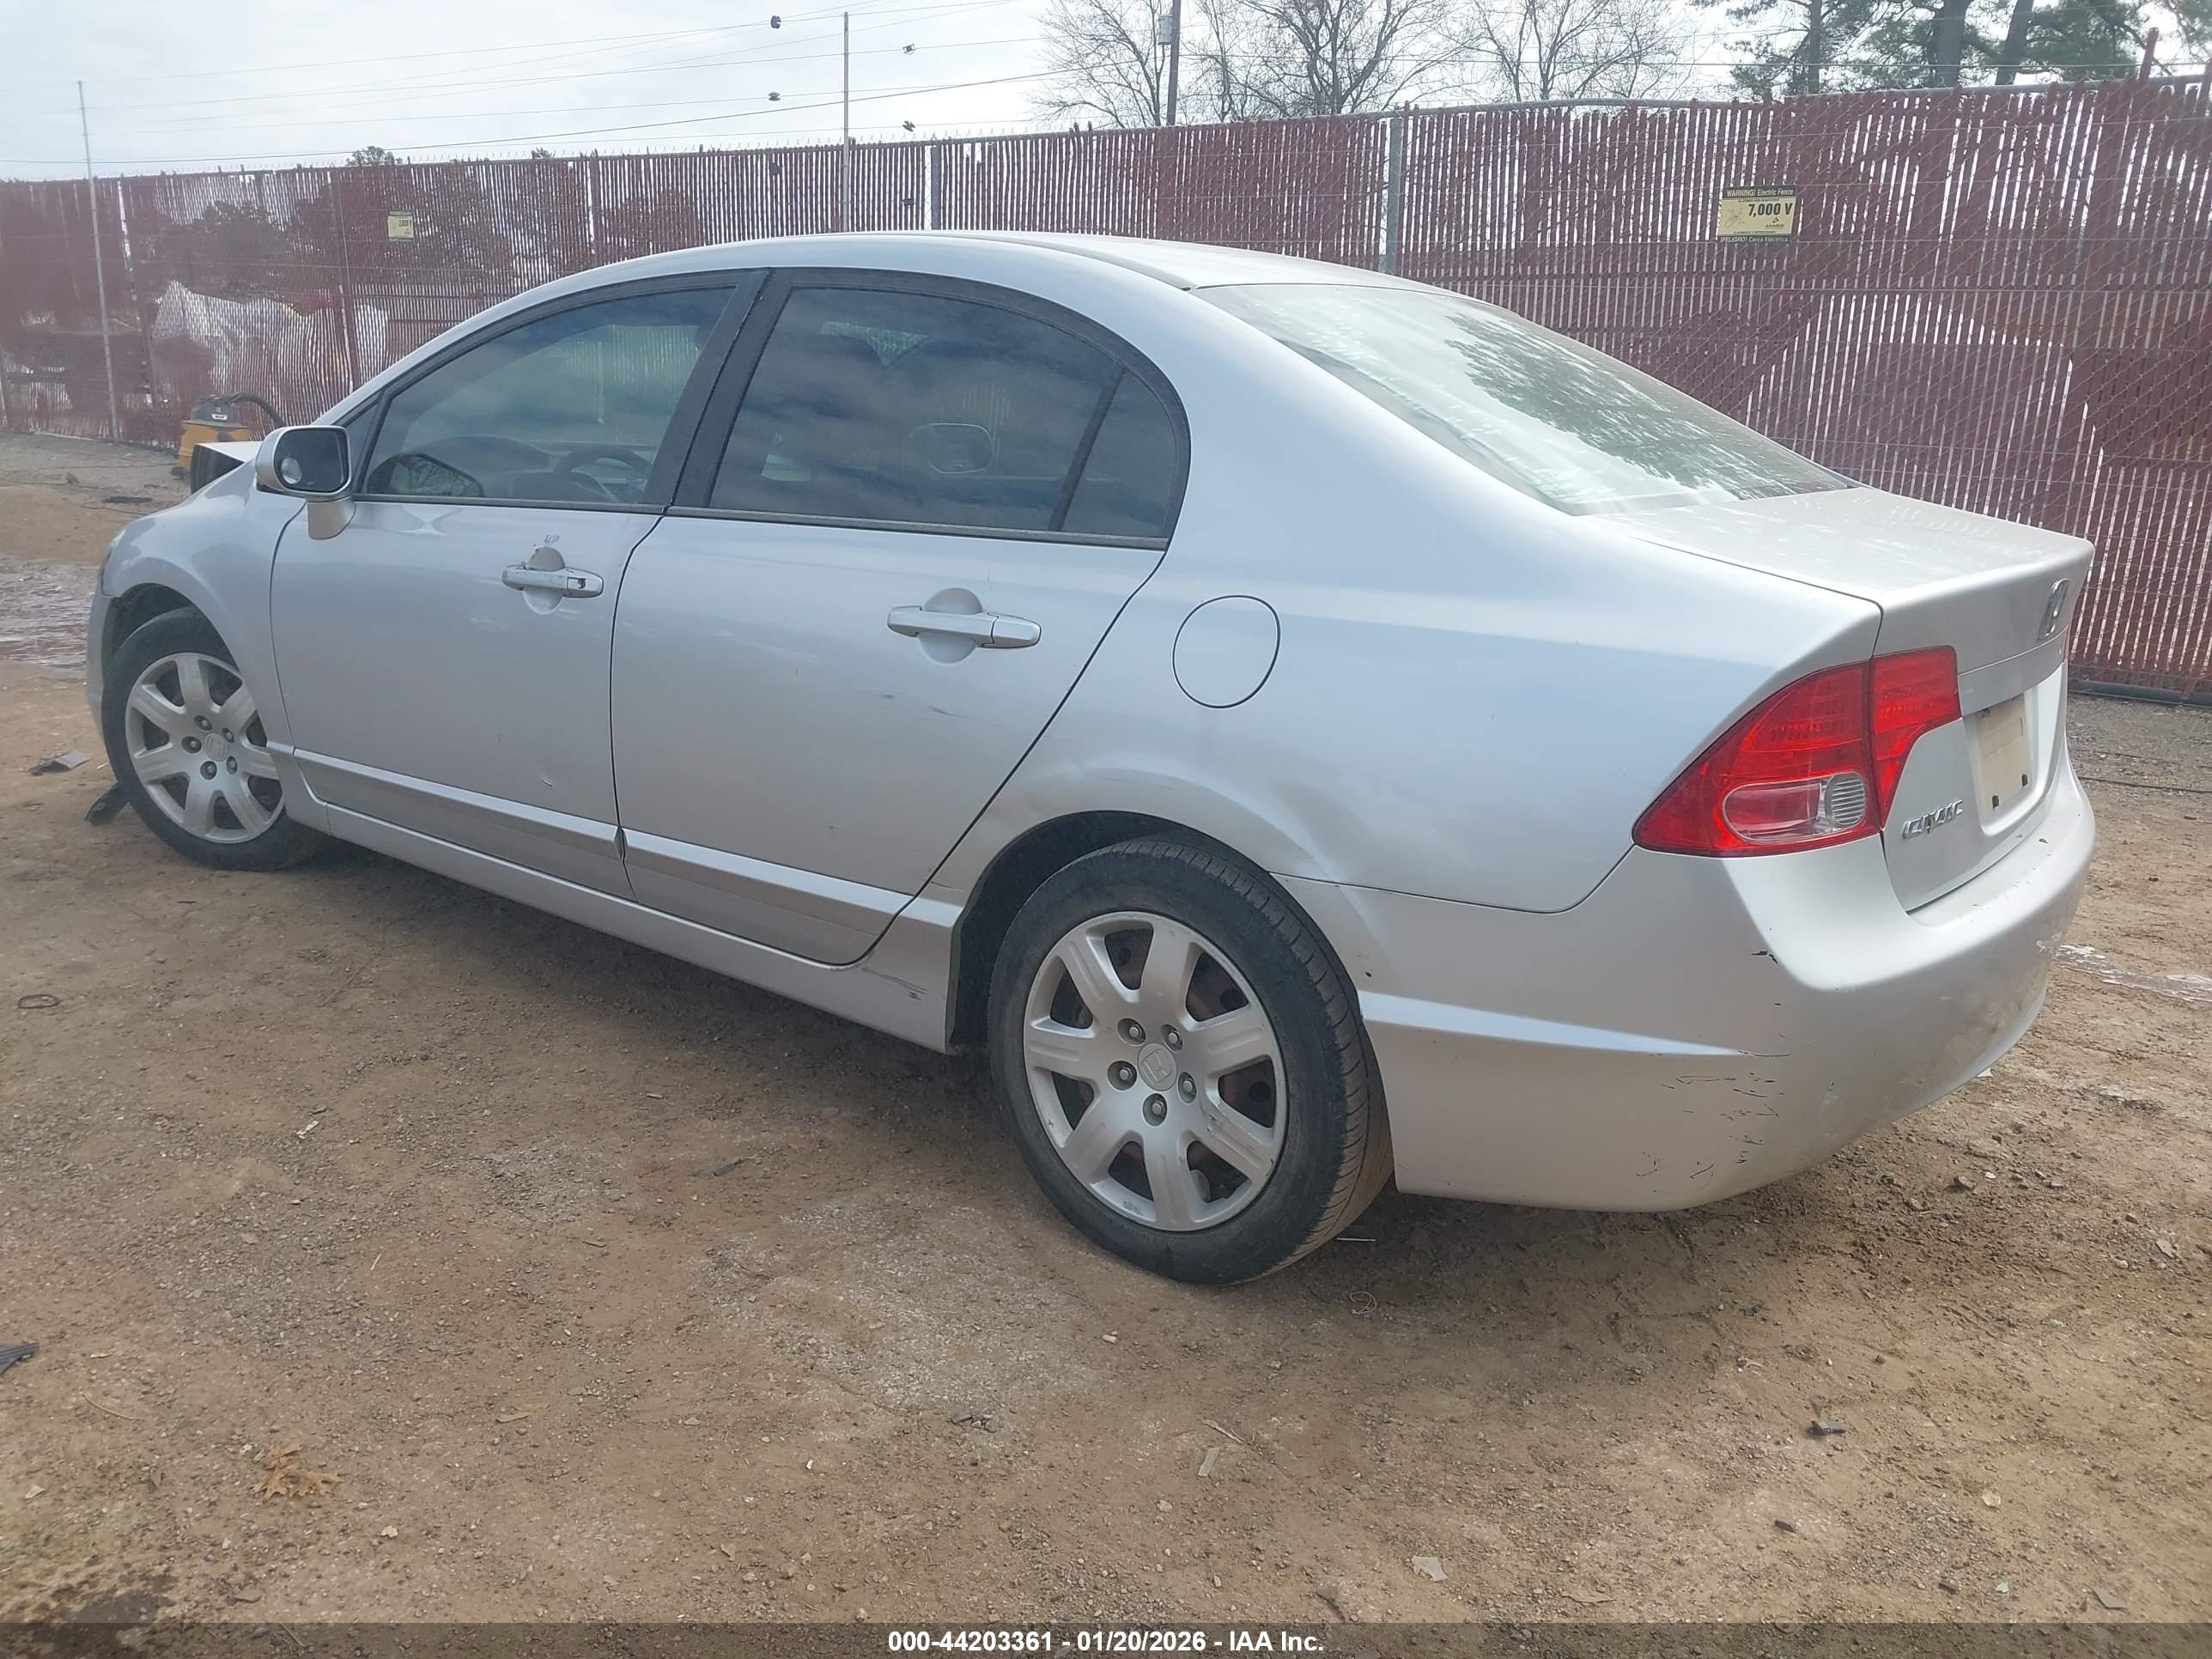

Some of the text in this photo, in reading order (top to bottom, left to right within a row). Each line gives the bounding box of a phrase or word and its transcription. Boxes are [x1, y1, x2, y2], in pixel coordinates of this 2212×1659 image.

[1748, 203, 1793, 217] 7,000 V
[1902, 799, 1963, 838] CIVIC
